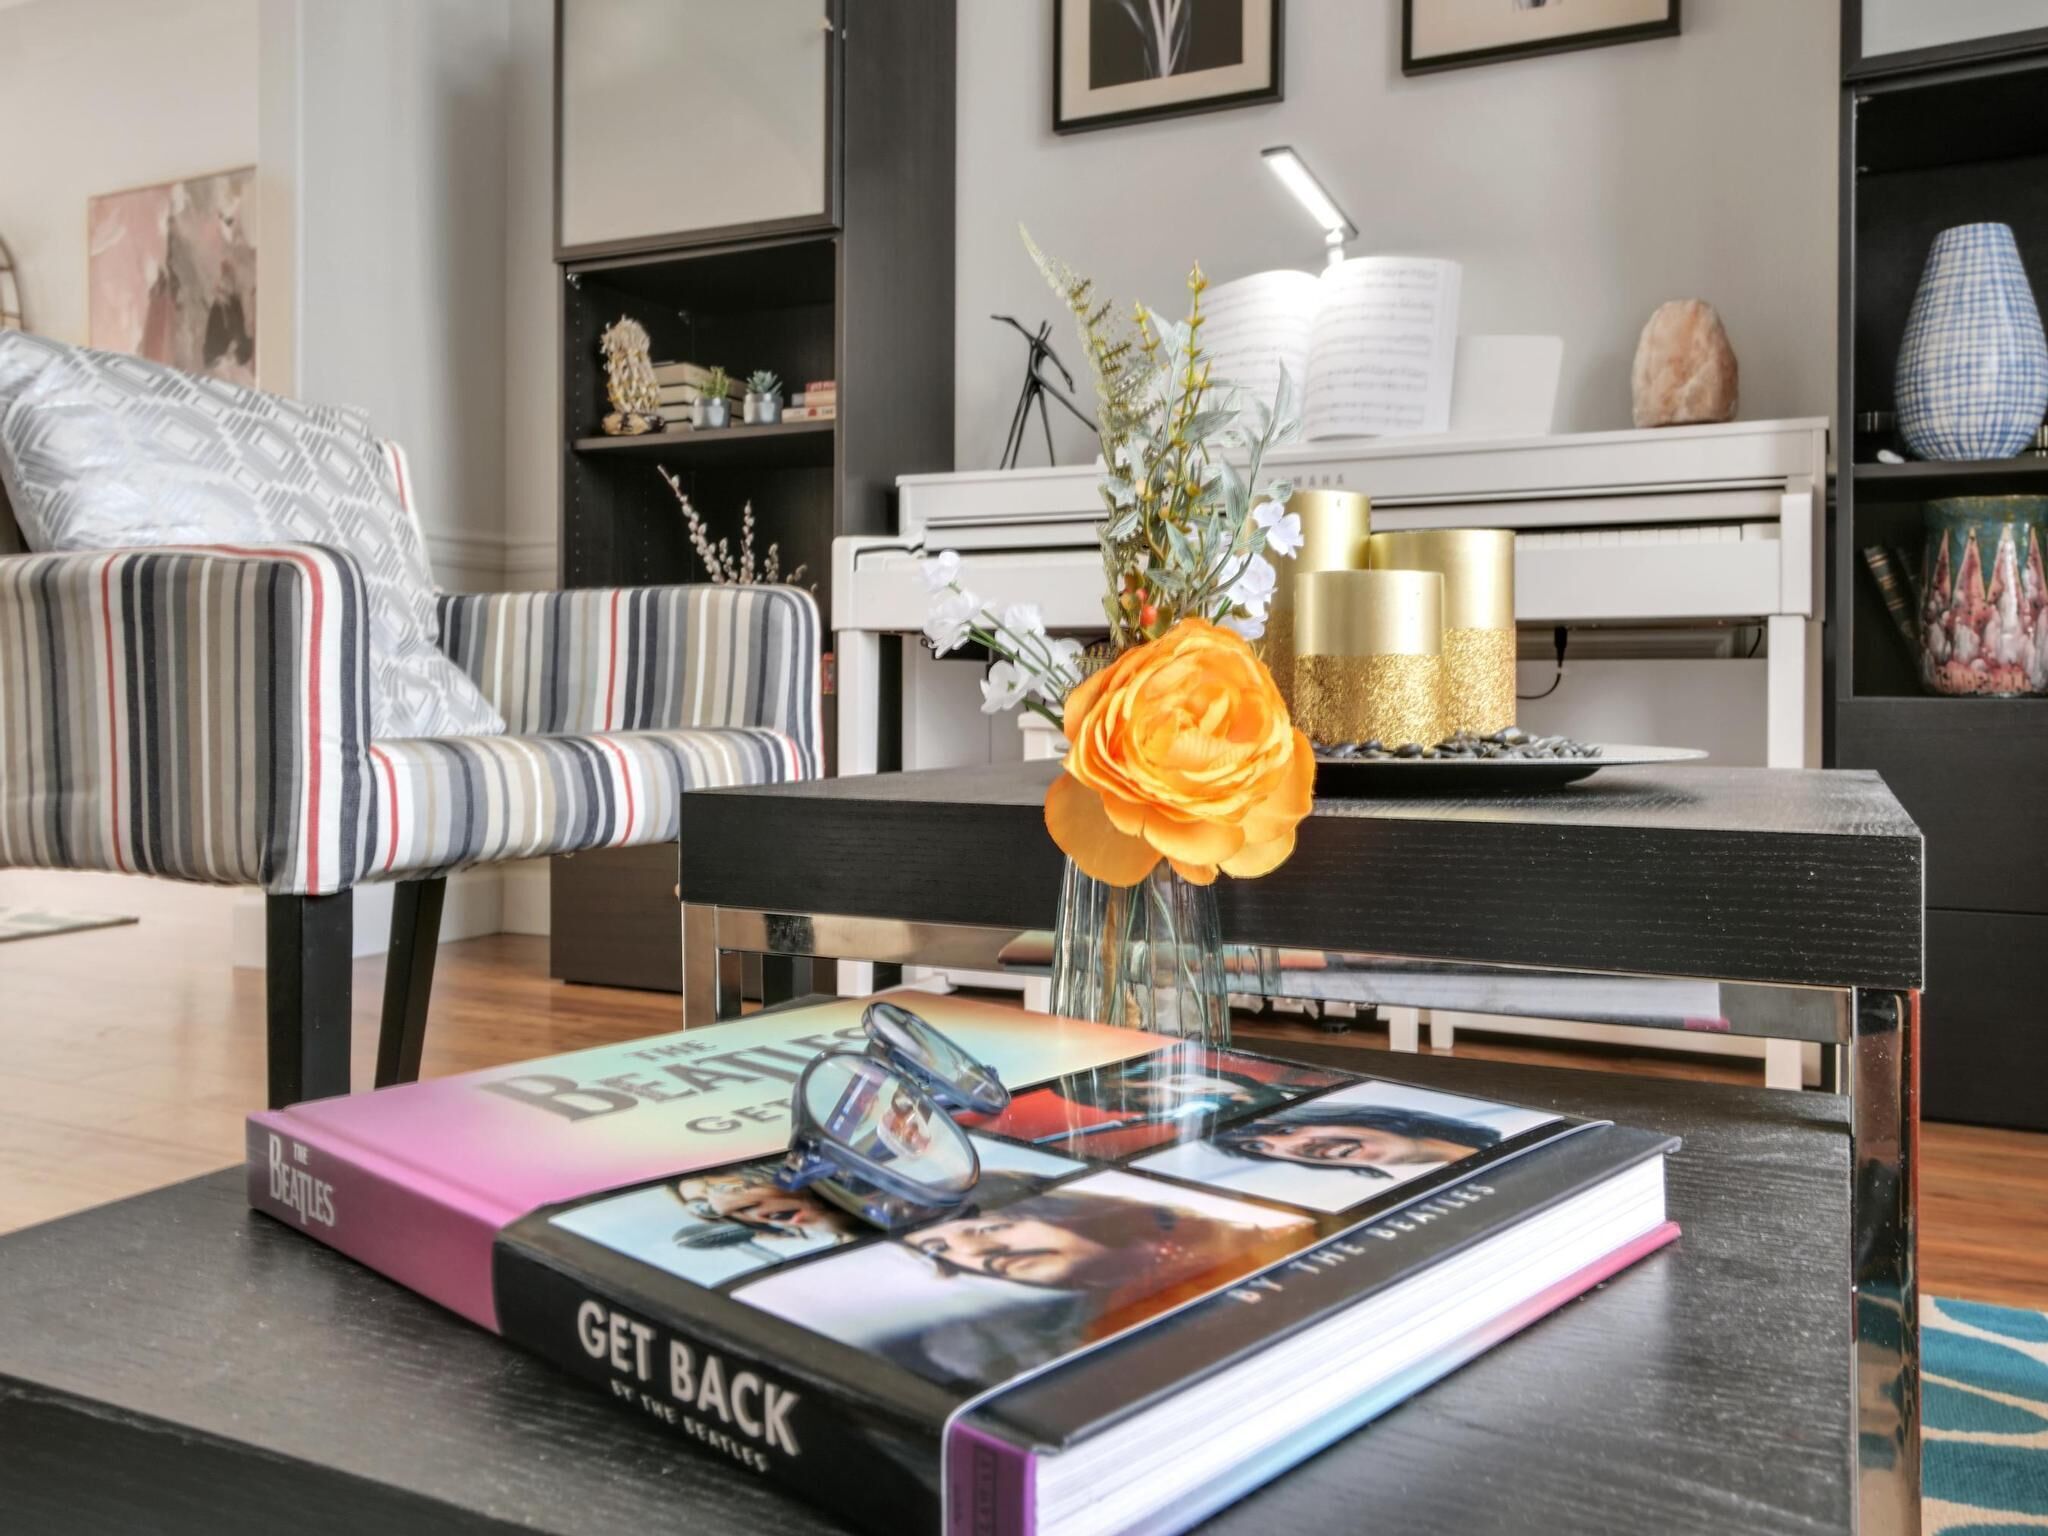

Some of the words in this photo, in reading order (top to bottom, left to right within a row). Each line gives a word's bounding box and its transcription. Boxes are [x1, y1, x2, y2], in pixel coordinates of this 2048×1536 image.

[1267, 473, 1344, 488] MAHA
[624, 1040, 718, 1063] THE
[268, 1133, 336, 1227] BEATLES
[293, 1142, 309, 1165] THE
[1226, 1276, 1283, 1304] BY
[1289, 1240, 1366, 1275] THE
[1366, 1183, 1496, 1240] BEATLES
[577, 1299, 656, 1382] GET
[669, 1338, 800, 1456] BACK
[611, 1378, 634, 1401] BY
[640, 1394, 678, 1424] THE
[682, 1415, 770, 1472] BEATLES
